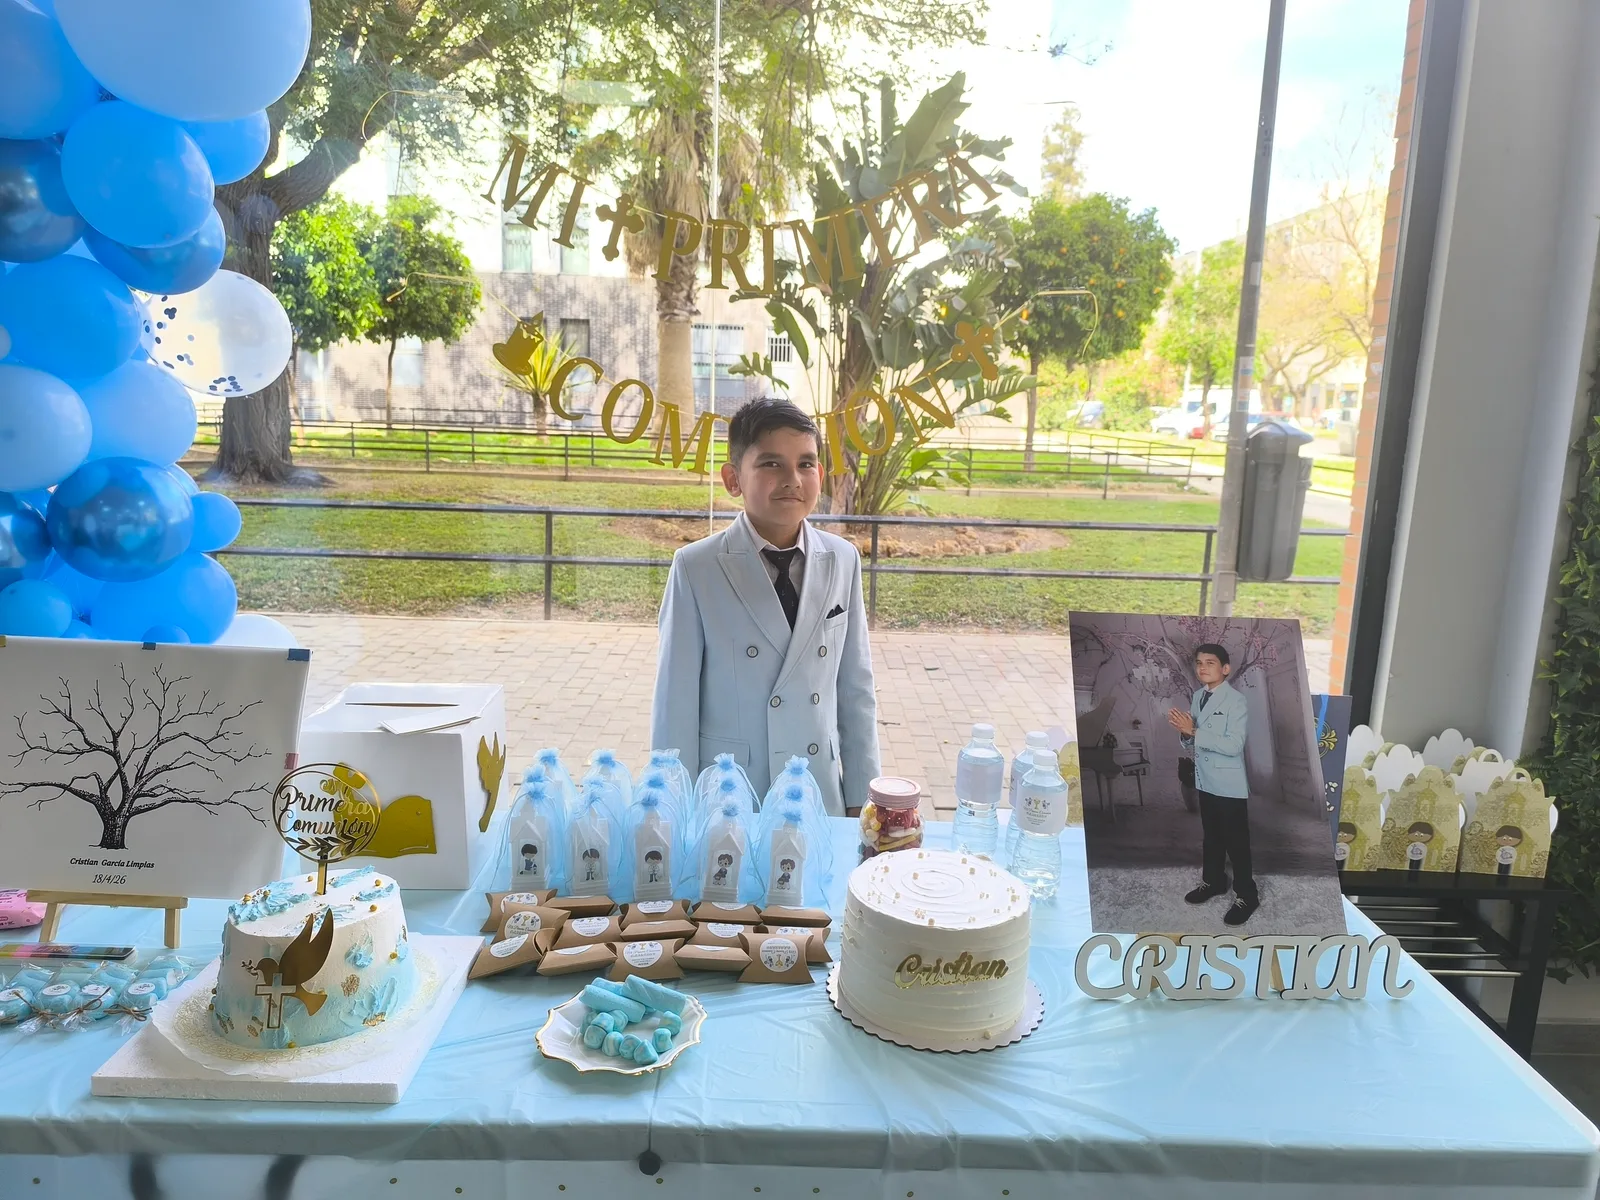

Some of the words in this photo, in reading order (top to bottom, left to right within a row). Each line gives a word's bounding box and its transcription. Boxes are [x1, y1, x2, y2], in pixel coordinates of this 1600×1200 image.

[480, 133, 593, 249] MI
[651, 151, 1002, 297] PRIMERA
[547, 356, 956, 477] COMION
[279, 784, 372, 815] Primera
[69, 857, 99, 866] Cristian
[92, 873, 127, 884] 18/4/26
[894, 951, 1009, 990] Cristian
